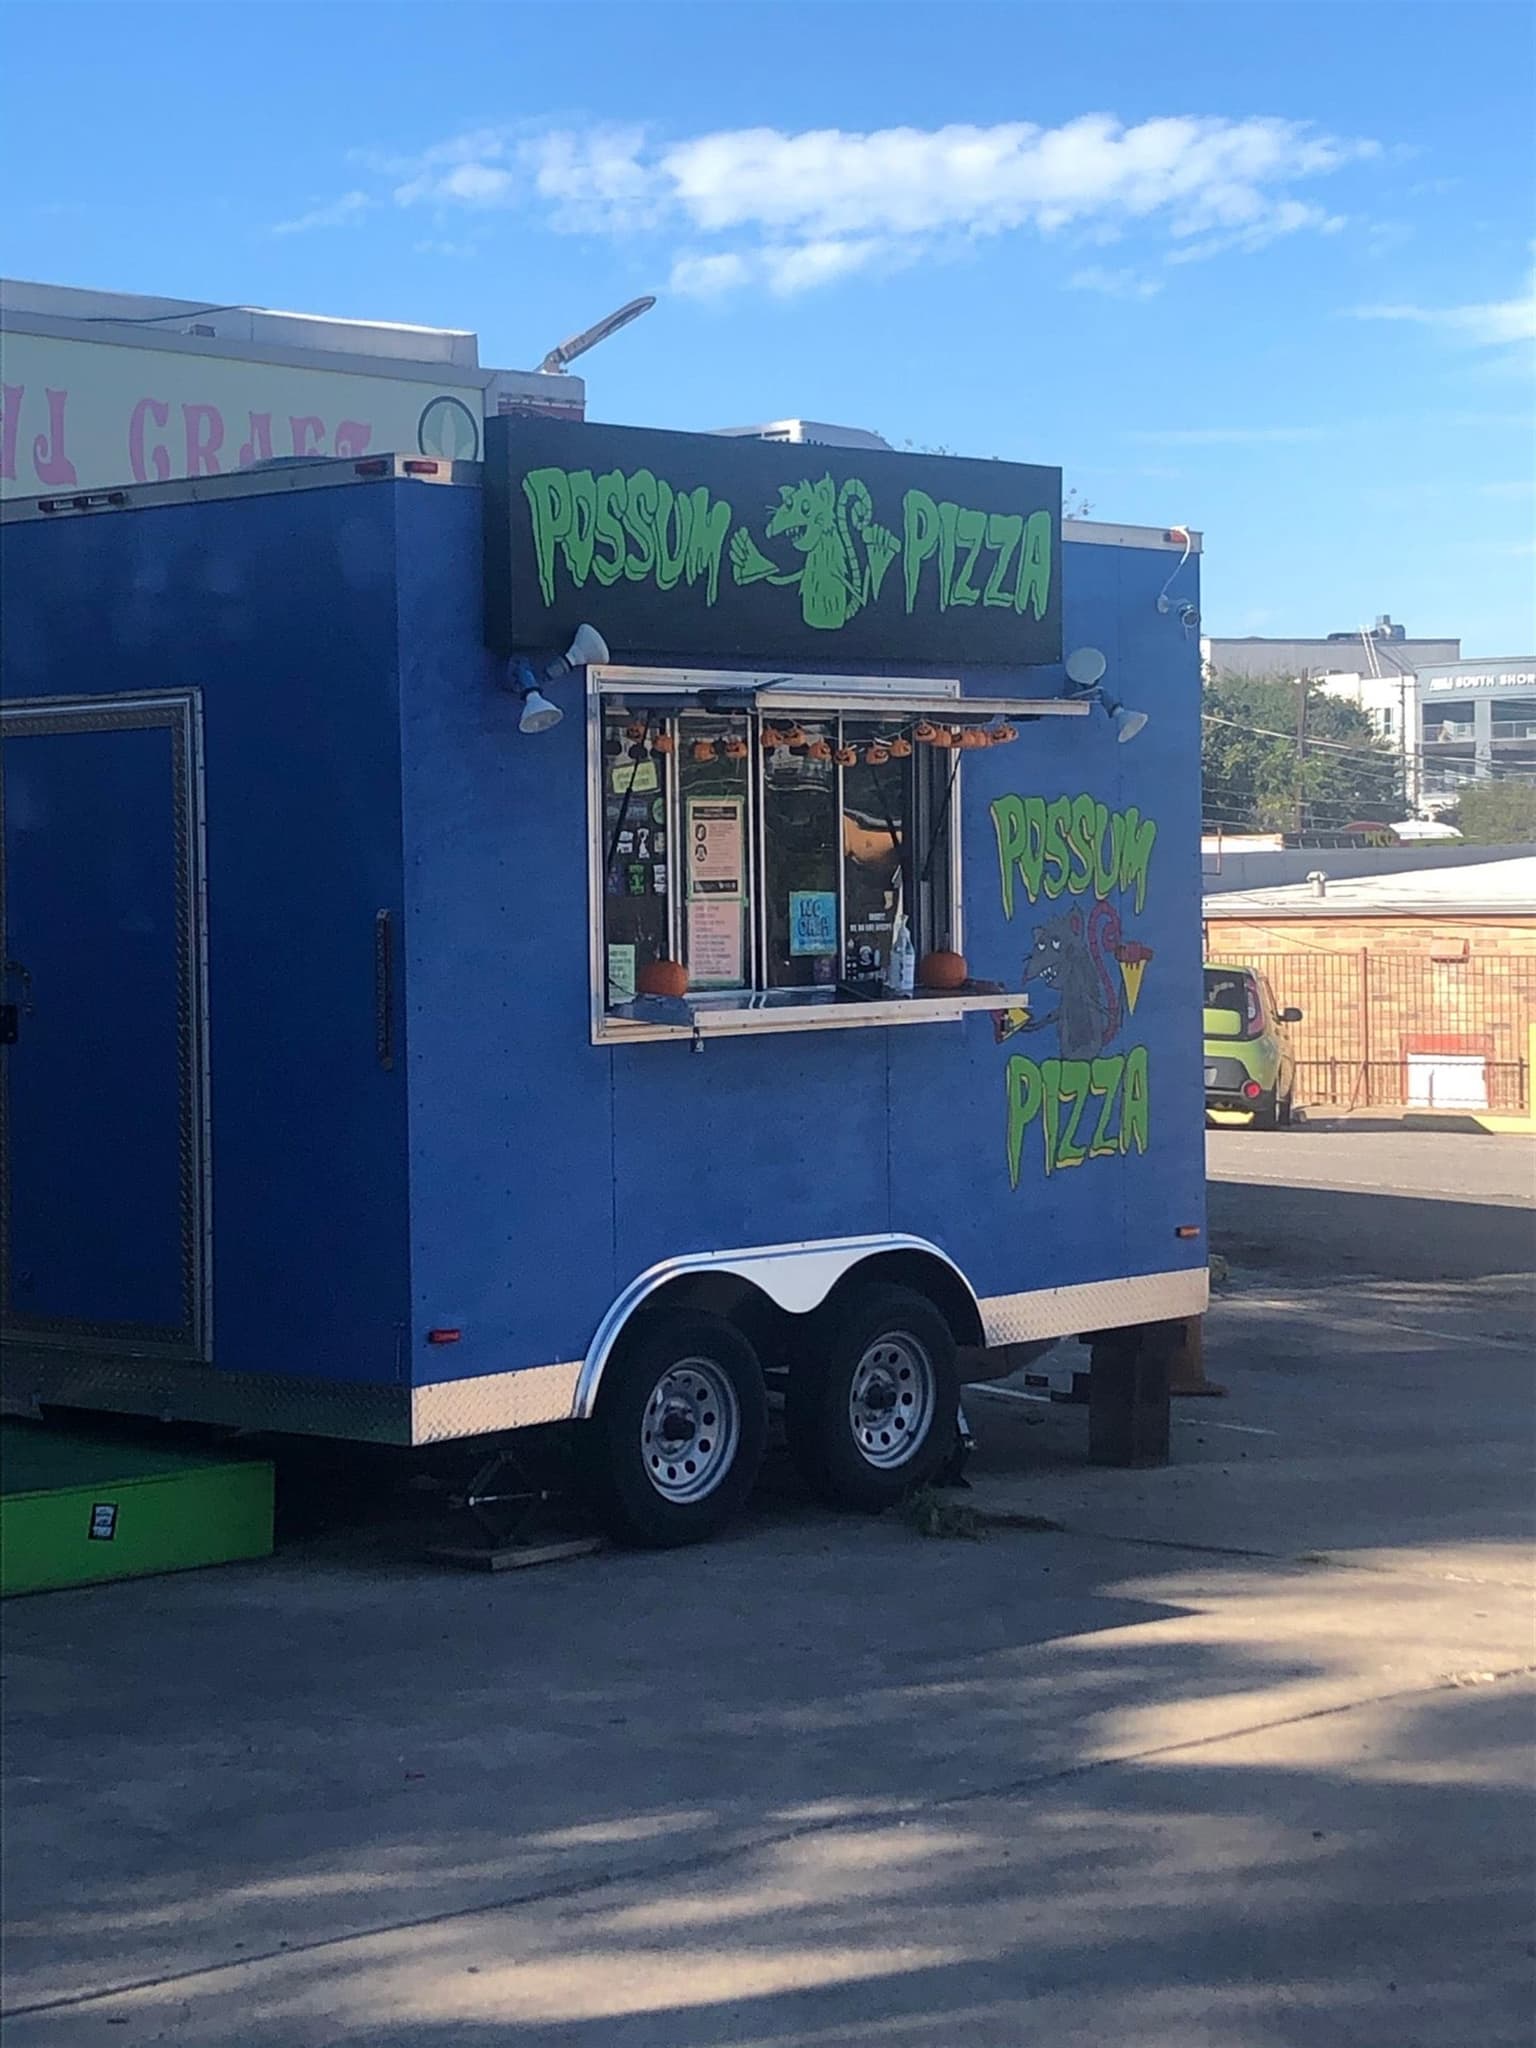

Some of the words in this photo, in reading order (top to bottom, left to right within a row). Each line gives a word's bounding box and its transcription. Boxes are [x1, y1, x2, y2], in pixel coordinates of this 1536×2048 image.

[523, 467, 731, 608] POSSUM
[903, 489, 1052, 621] PIZZA
[1456, 675, 1495, 688] SOUTH
[989, 793, 1158, 920] POSSUM
[1007, 1045, 1150, 1191] PIZZA
